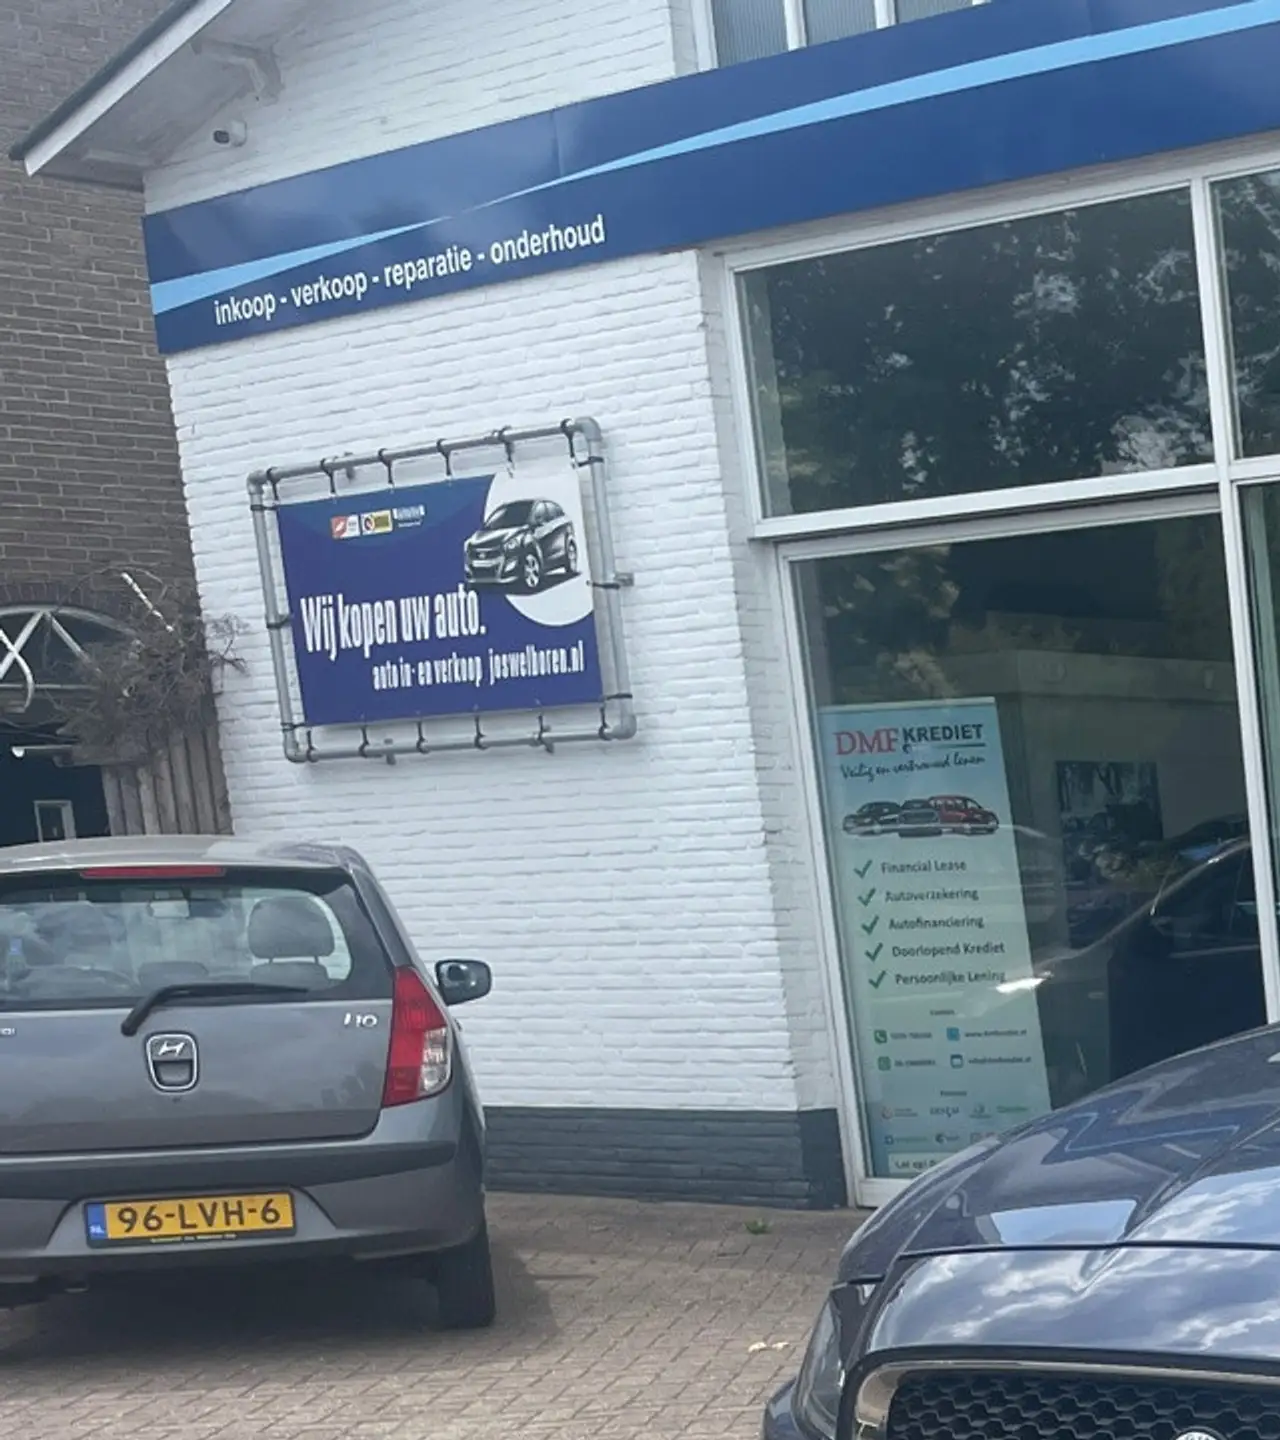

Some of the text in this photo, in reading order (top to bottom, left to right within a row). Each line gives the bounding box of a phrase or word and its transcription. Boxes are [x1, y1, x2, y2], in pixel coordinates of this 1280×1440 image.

[214, 292, 277, 326] inkoop
[290, 271, 368, 307] verkoop
[383, 247, 473, 289] reparatie
[489, 214, 606, 265] onderhoud
[300, 583, 486, 661] Wij kopen uw auto.
[372, 660, 399, 690] auto
[418, 660, 433, 686] en
[433, 652, 483, 687] verkoop
[834, 724, 984, 755] DMF KREDIET
[881, 860, 967, 875] Financial Lease
[885, 889, 979, 902] Autoverzekering
[889, 916, 984, 930] Autofinanciering
[892, 942, 1005, 958] Doorlopend Krediet
[896, 971, 965, 986] Persoonlijke
[118, 1199, 281, 1233] 96-LVH-6
